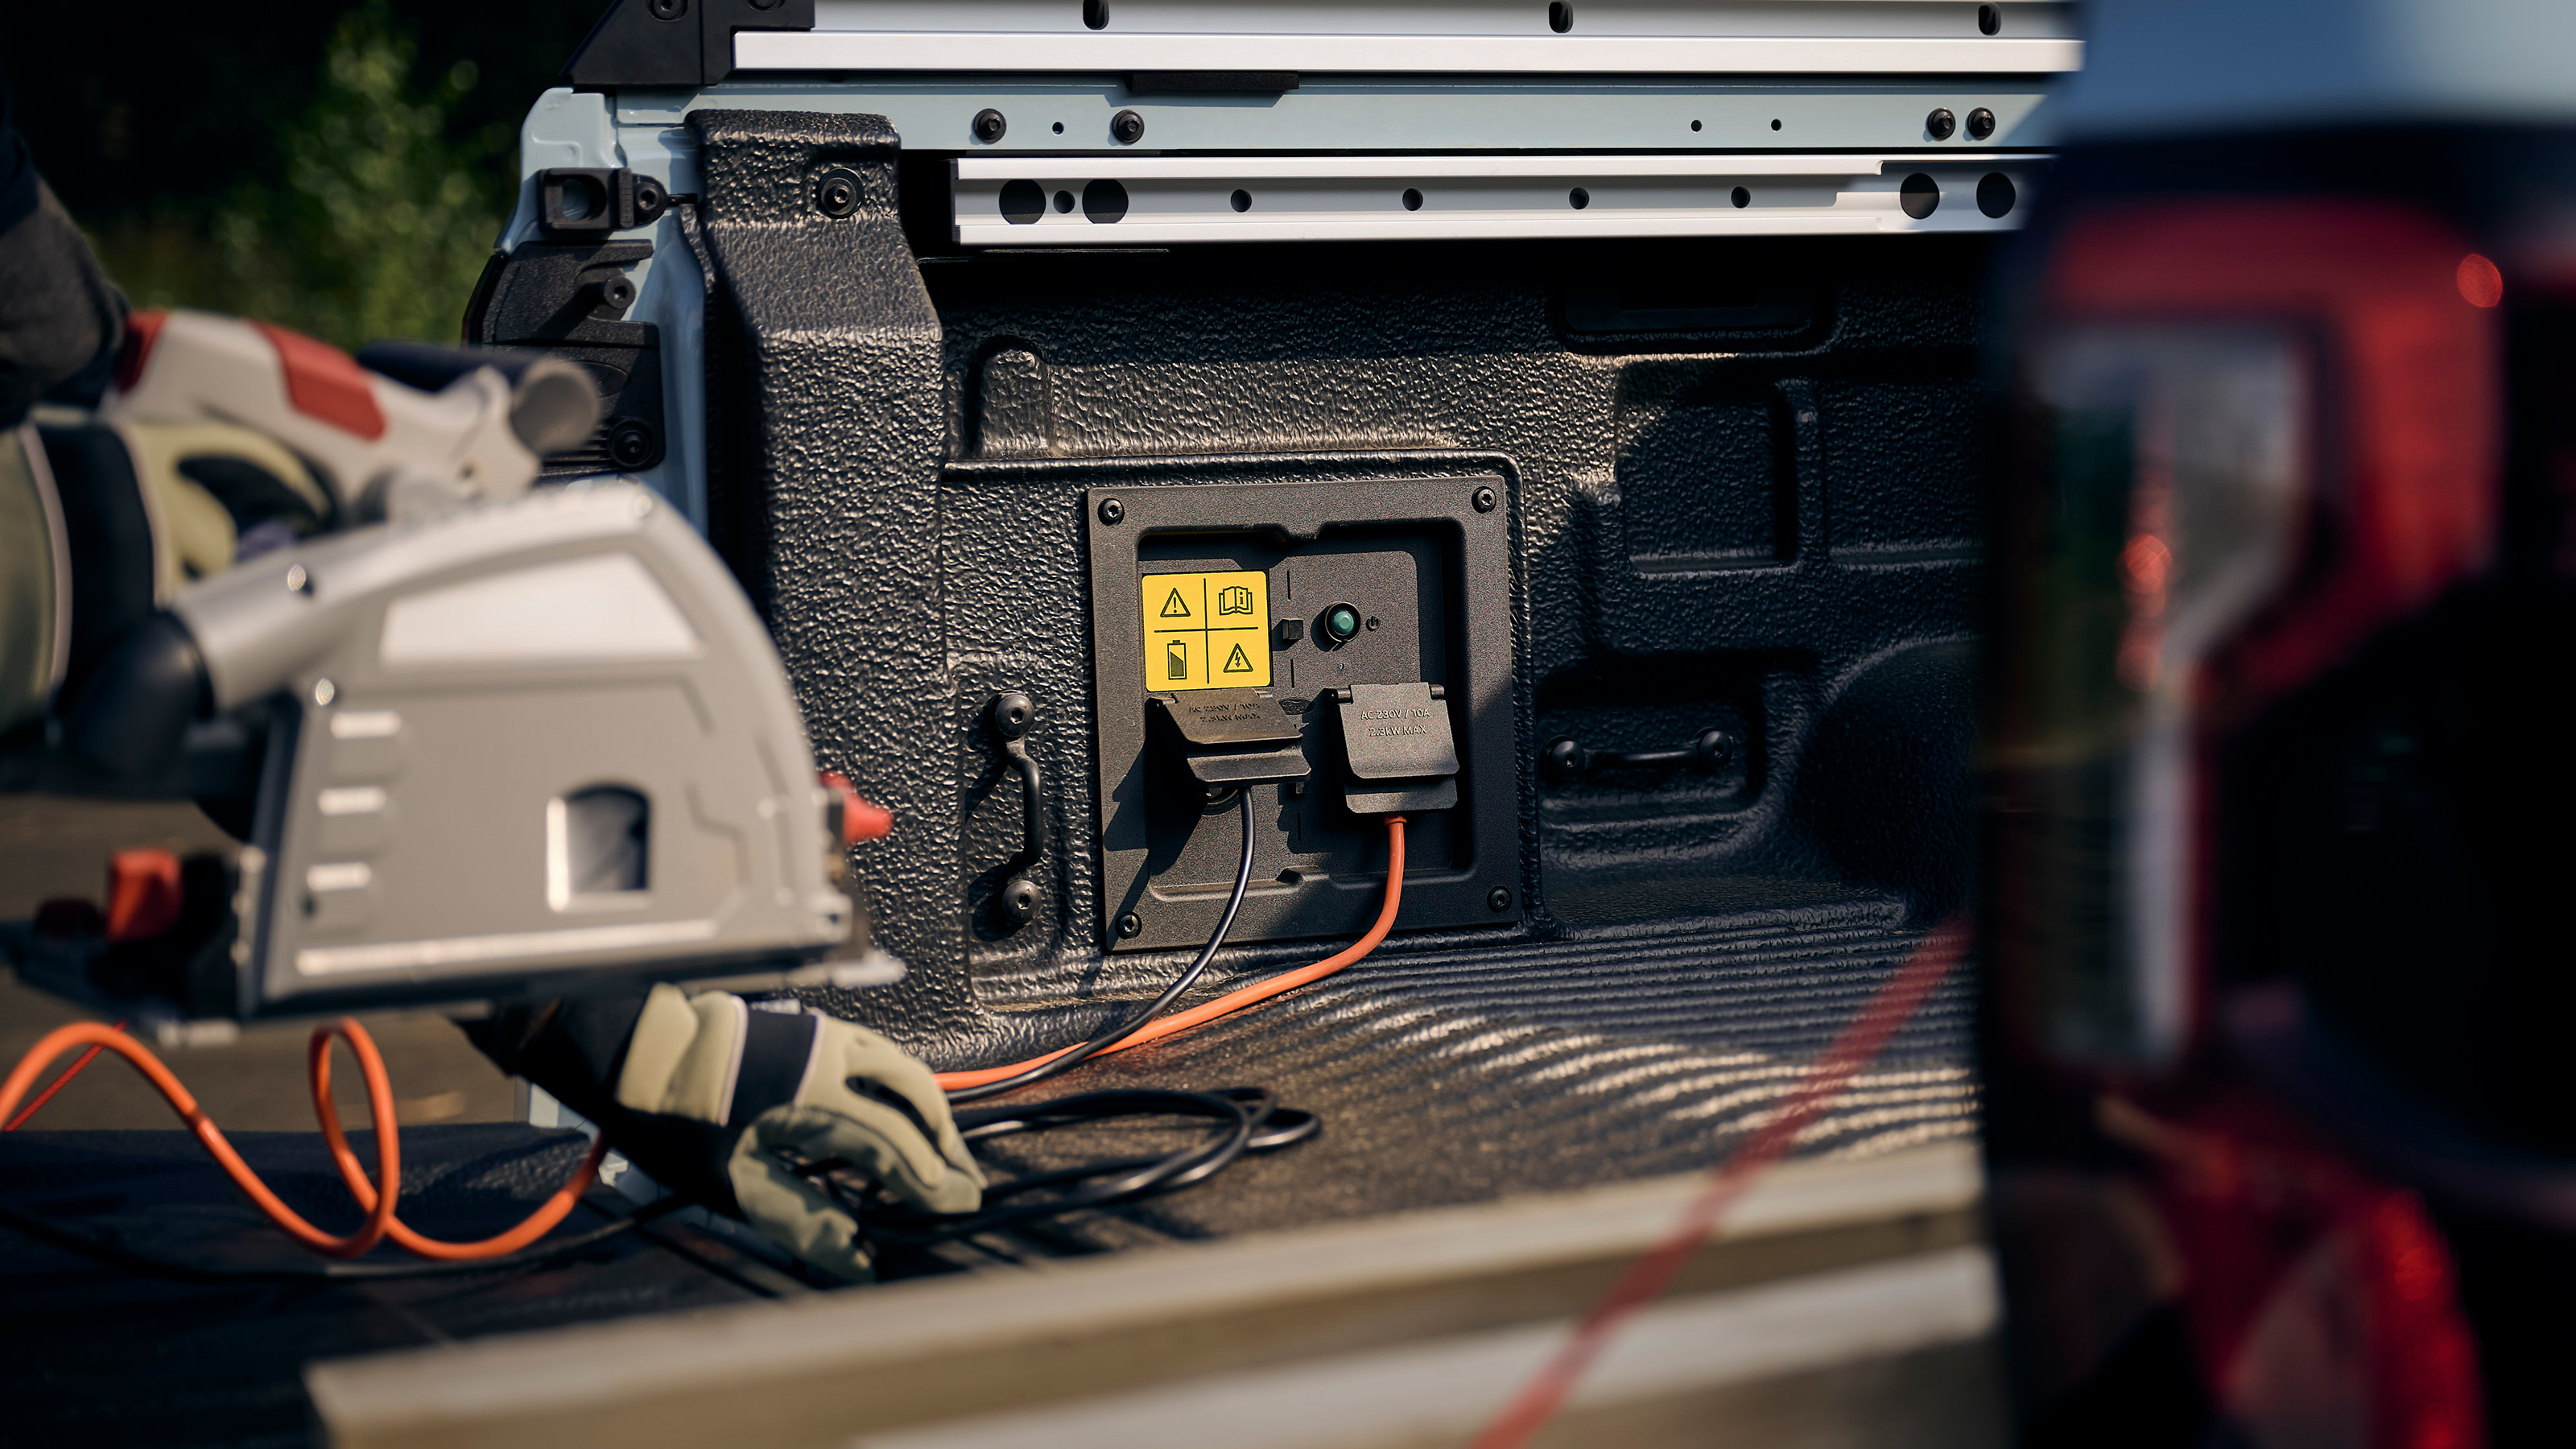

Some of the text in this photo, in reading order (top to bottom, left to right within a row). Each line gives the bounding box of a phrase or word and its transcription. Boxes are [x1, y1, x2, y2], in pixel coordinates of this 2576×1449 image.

[1235, 713, 1261, 721] MAX
[1360, 711, 1373, 720] AC
[1376, 709, 1402, 720] 230V
[1411, 708, 1430, 718] 10A
[1368, 724, 1427, 737] 2.3kW MAX
